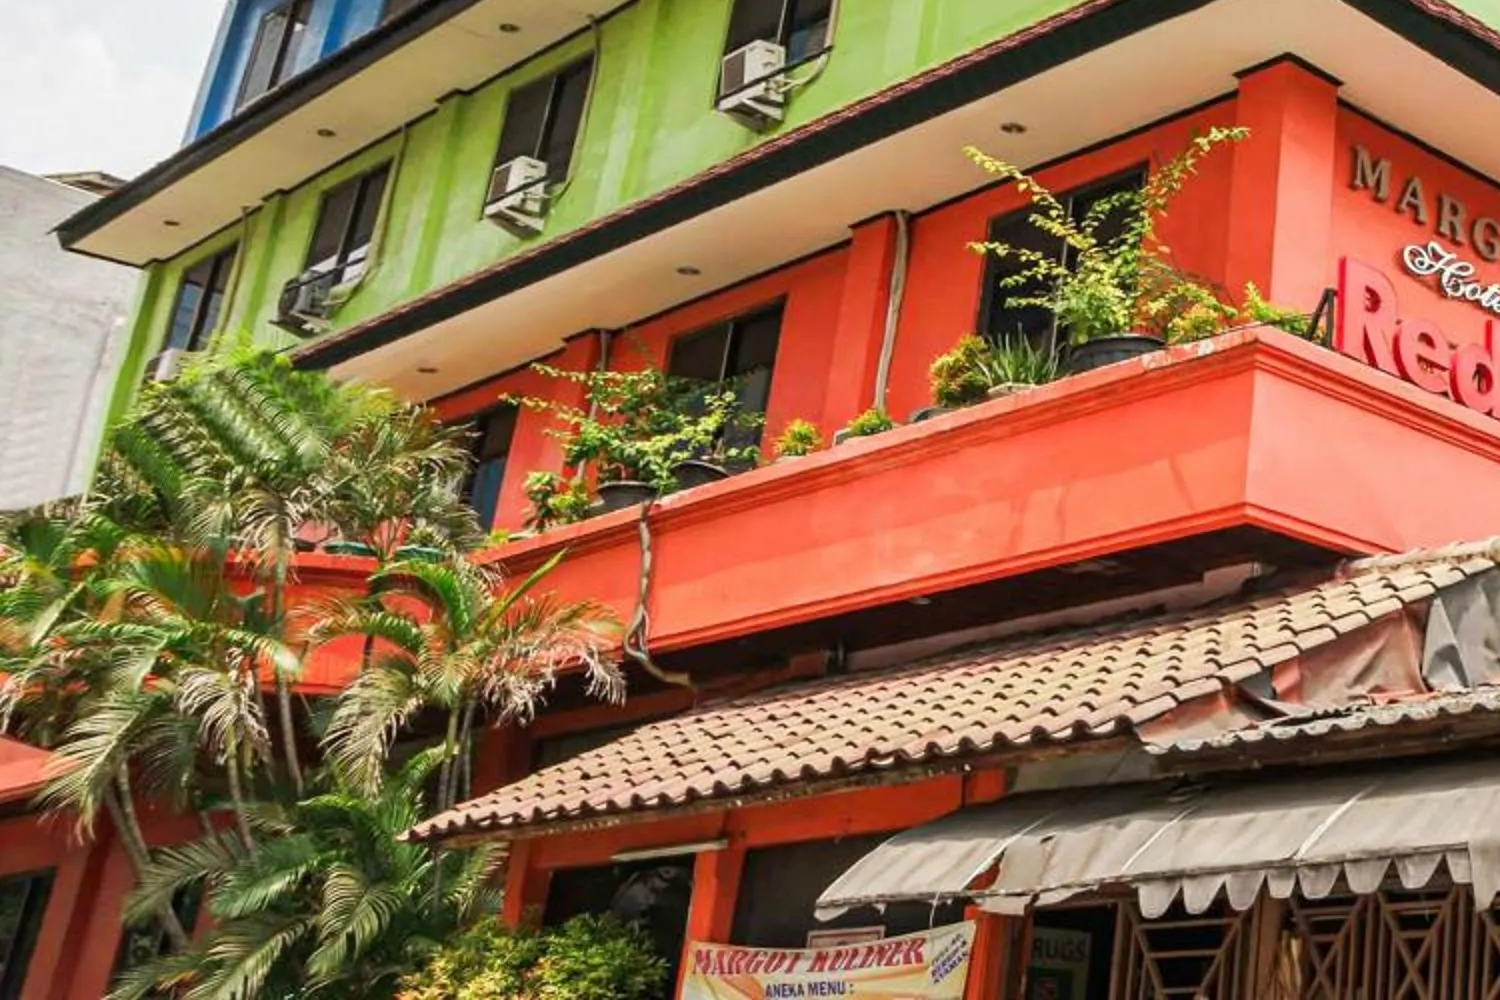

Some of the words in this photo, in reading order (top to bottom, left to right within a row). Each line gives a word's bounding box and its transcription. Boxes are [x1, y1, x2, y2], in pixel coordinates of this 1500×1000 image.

[693, 949, 803, 975] MARGOT
[765, 983, 804, 998] ANEKA
[807, 981, 847, 997] MENU
